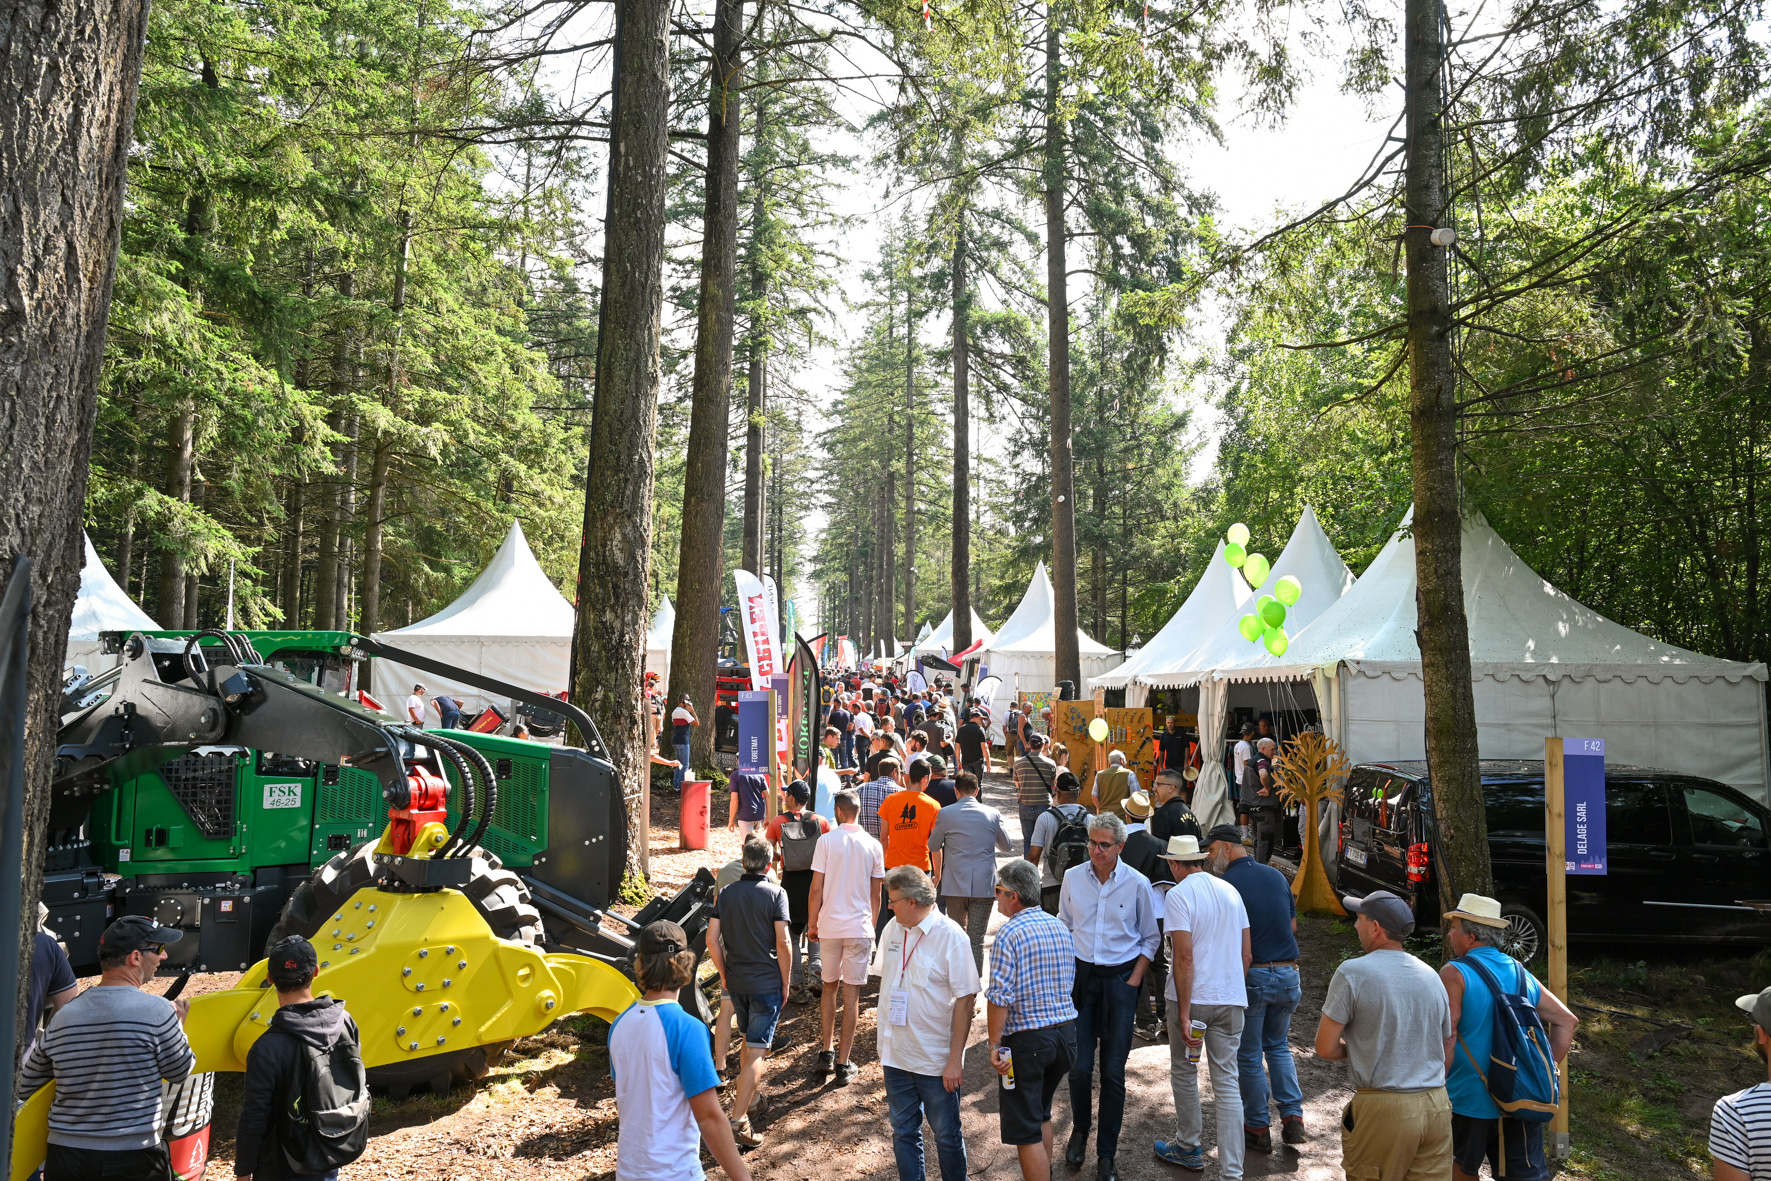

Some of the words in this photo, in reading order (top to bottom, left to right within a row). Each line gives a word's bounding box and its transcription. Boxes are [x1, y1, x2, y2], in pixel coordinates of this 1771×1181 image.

[1584, 741, 1588, 751] F
[1590, 741, 1601, 751] 42
[268, 785, 298, 798] FSK
[269, 797, 297, 807] 46-25
[1577, 801, 1587, 822] SARL
[1577, 823, 1588, 854] DELAGE
